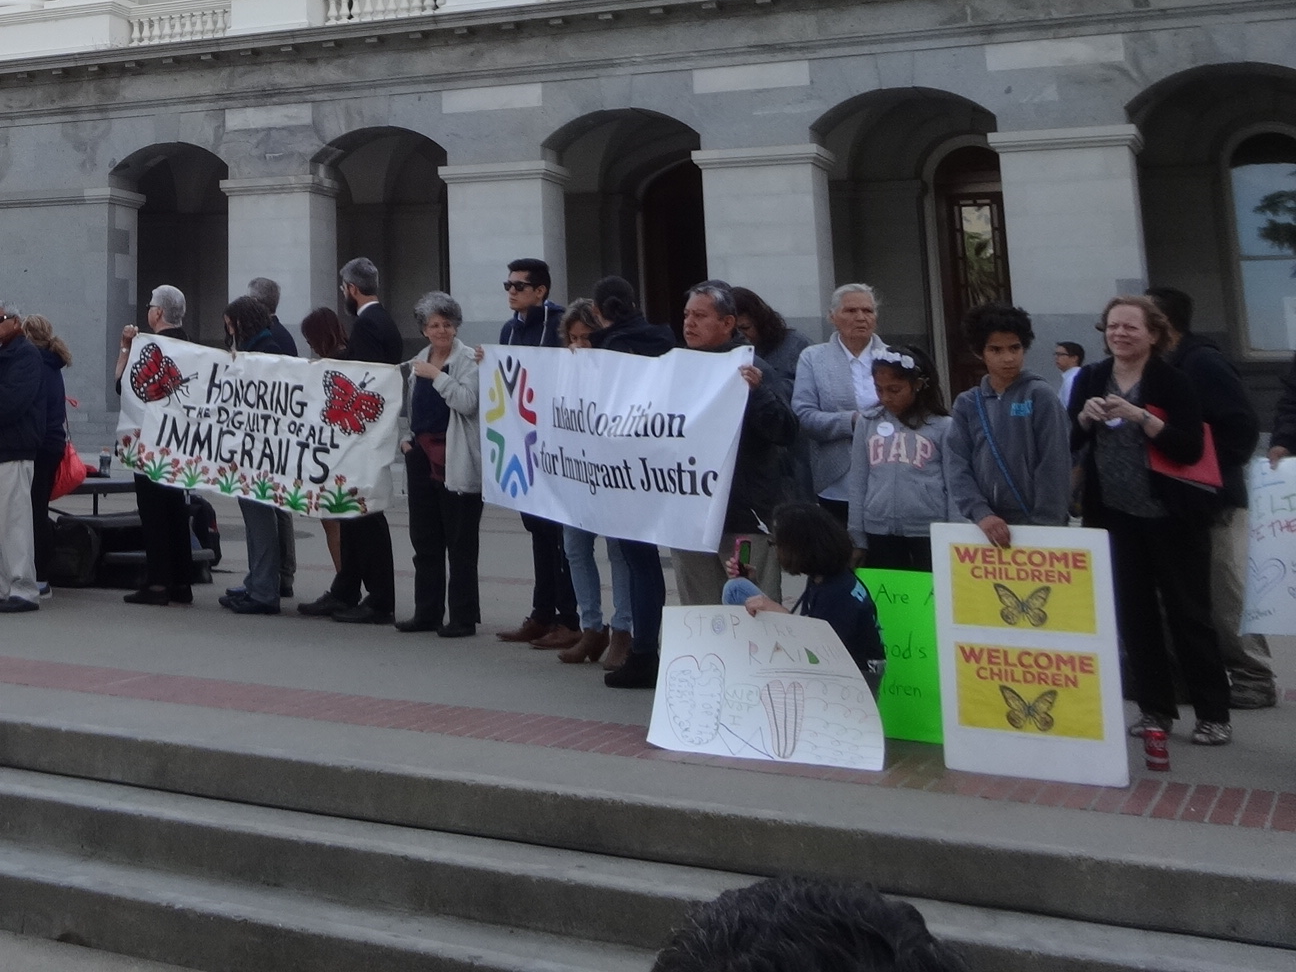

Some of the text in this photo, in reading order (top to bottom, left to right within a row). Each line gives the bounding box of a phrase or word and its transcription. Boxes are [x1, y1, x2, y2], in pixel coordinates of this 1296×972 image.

[206, 362, 308, 419] HONORING
[183, 404, 340, 450] THE DIGNITY OF ALL
[552, 396, 687, 439] Inland Coalition
[155, 413, 331, 485] IMMIGRANTS
[868, 432, 938, 469] GAP
[540, 440, 719, 498] for Immigrant Justic
[954, 546, 1088, 571] WELCOME
[970, 565, 1072, 584] CHILDREN
[875, 583, 910, 604] Are
[684, 610, 742, 640] STOP
[959, 645, 1095, 674] WELCOME
[882, 681, 922, 698] ldren
[976, 666, 1080, 689] CHILDREN
